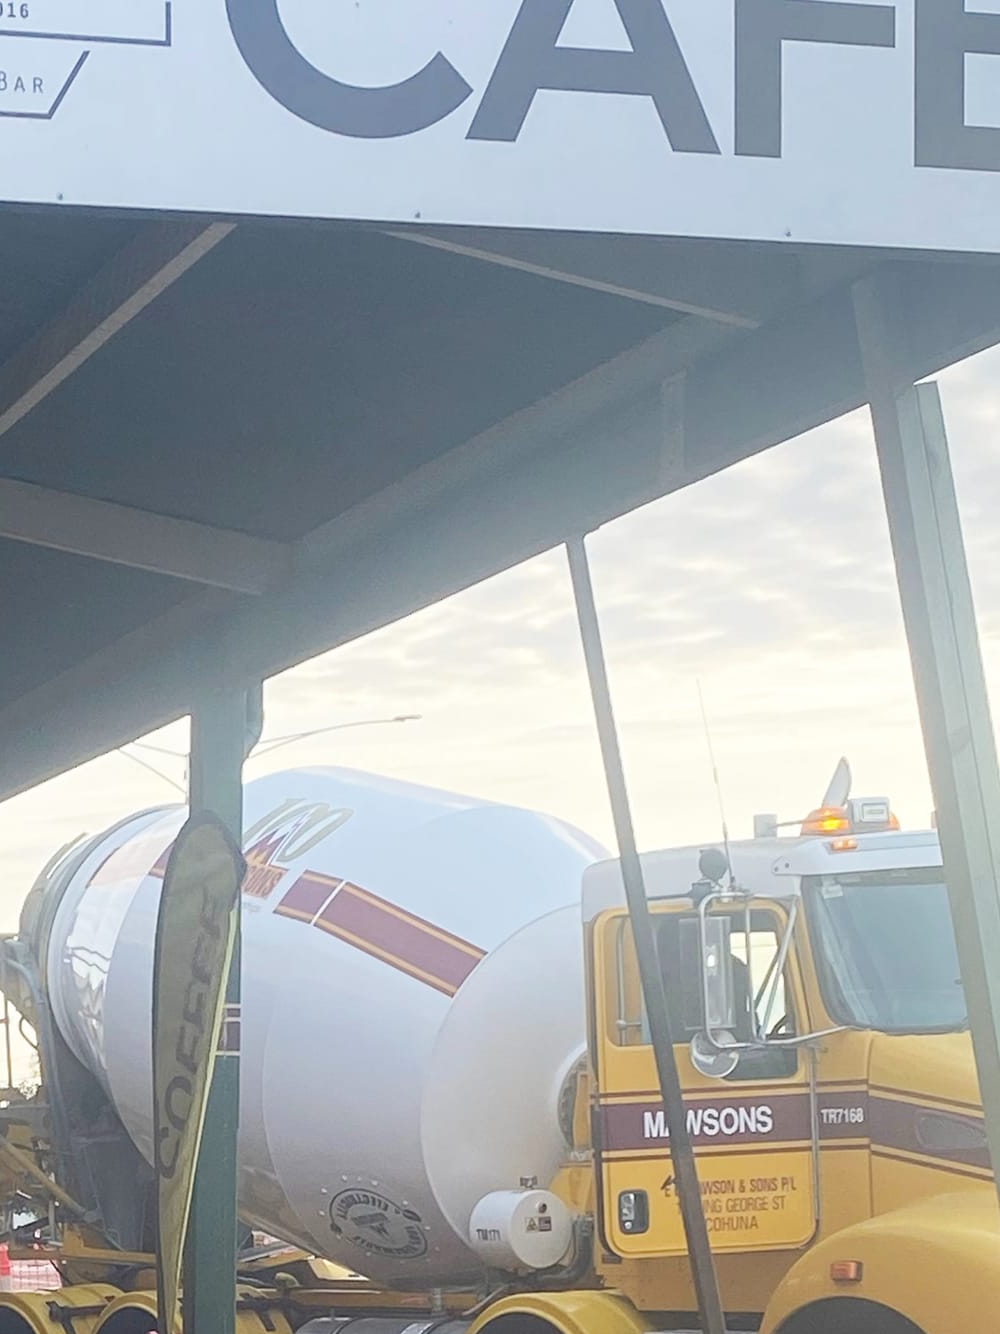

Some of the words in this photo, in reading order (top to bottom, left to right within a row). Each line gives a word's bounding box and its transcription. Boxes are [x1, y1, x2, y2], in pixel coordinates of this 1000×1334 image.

[644, 1105, 773, 1138] MWSONS
[821, 1107, 864, 1124] TR7168
[749, 1177, 778, 1193] SONS
[726, 1196, 769, 1213] GEORGE
[772, 1195, 786, 1211] ST
